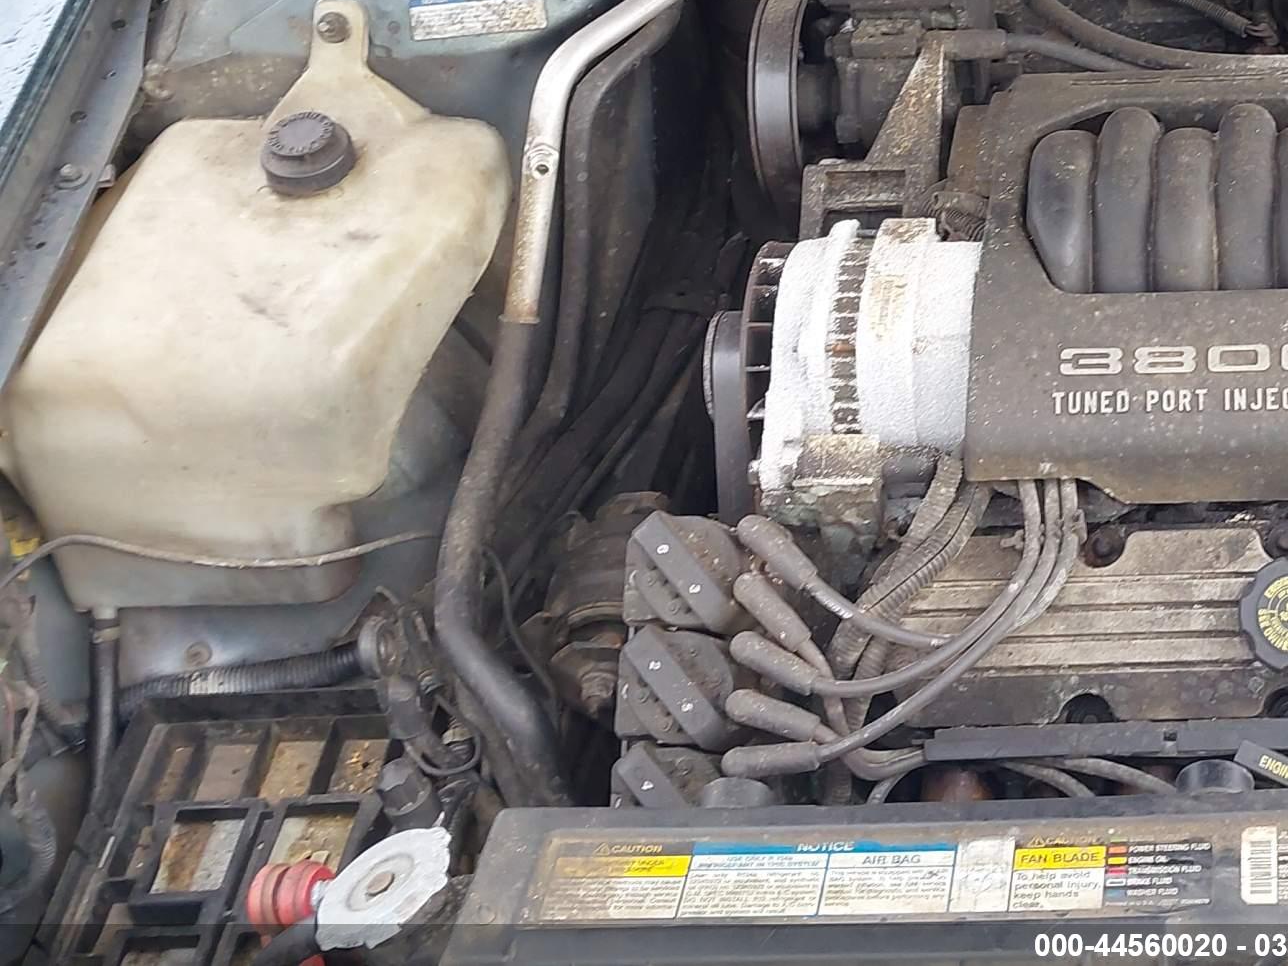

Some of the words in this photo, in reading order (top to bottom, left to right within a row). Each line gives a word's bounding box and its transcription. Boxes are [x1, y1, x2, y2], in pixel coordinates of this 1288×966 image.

[1052, 390, 1130, 415] TUNED
[1145, 388, 1208, 412] PORT
[611, 845, 663, 853] CAUTION
[796, 842, 855, 852] NOTICE
[862, 855, 886, 865] AIR
[891, 855, 921, 864] BAG
[1021, 854, 1047, 864] FAN
[1053, 852, 1100, 863] BLADE
[1155, 855, 1168, 863] OIL
[1032, 872, 1056, 881] help
[1152, 877, 1173, 885] FLUID
[1015, 881, 1063, 890] personal
[1068, 881, 1101, 889] injury,
[1014, 891, 1041, 900] keep
[1045, 890, 1079, 898] hands
